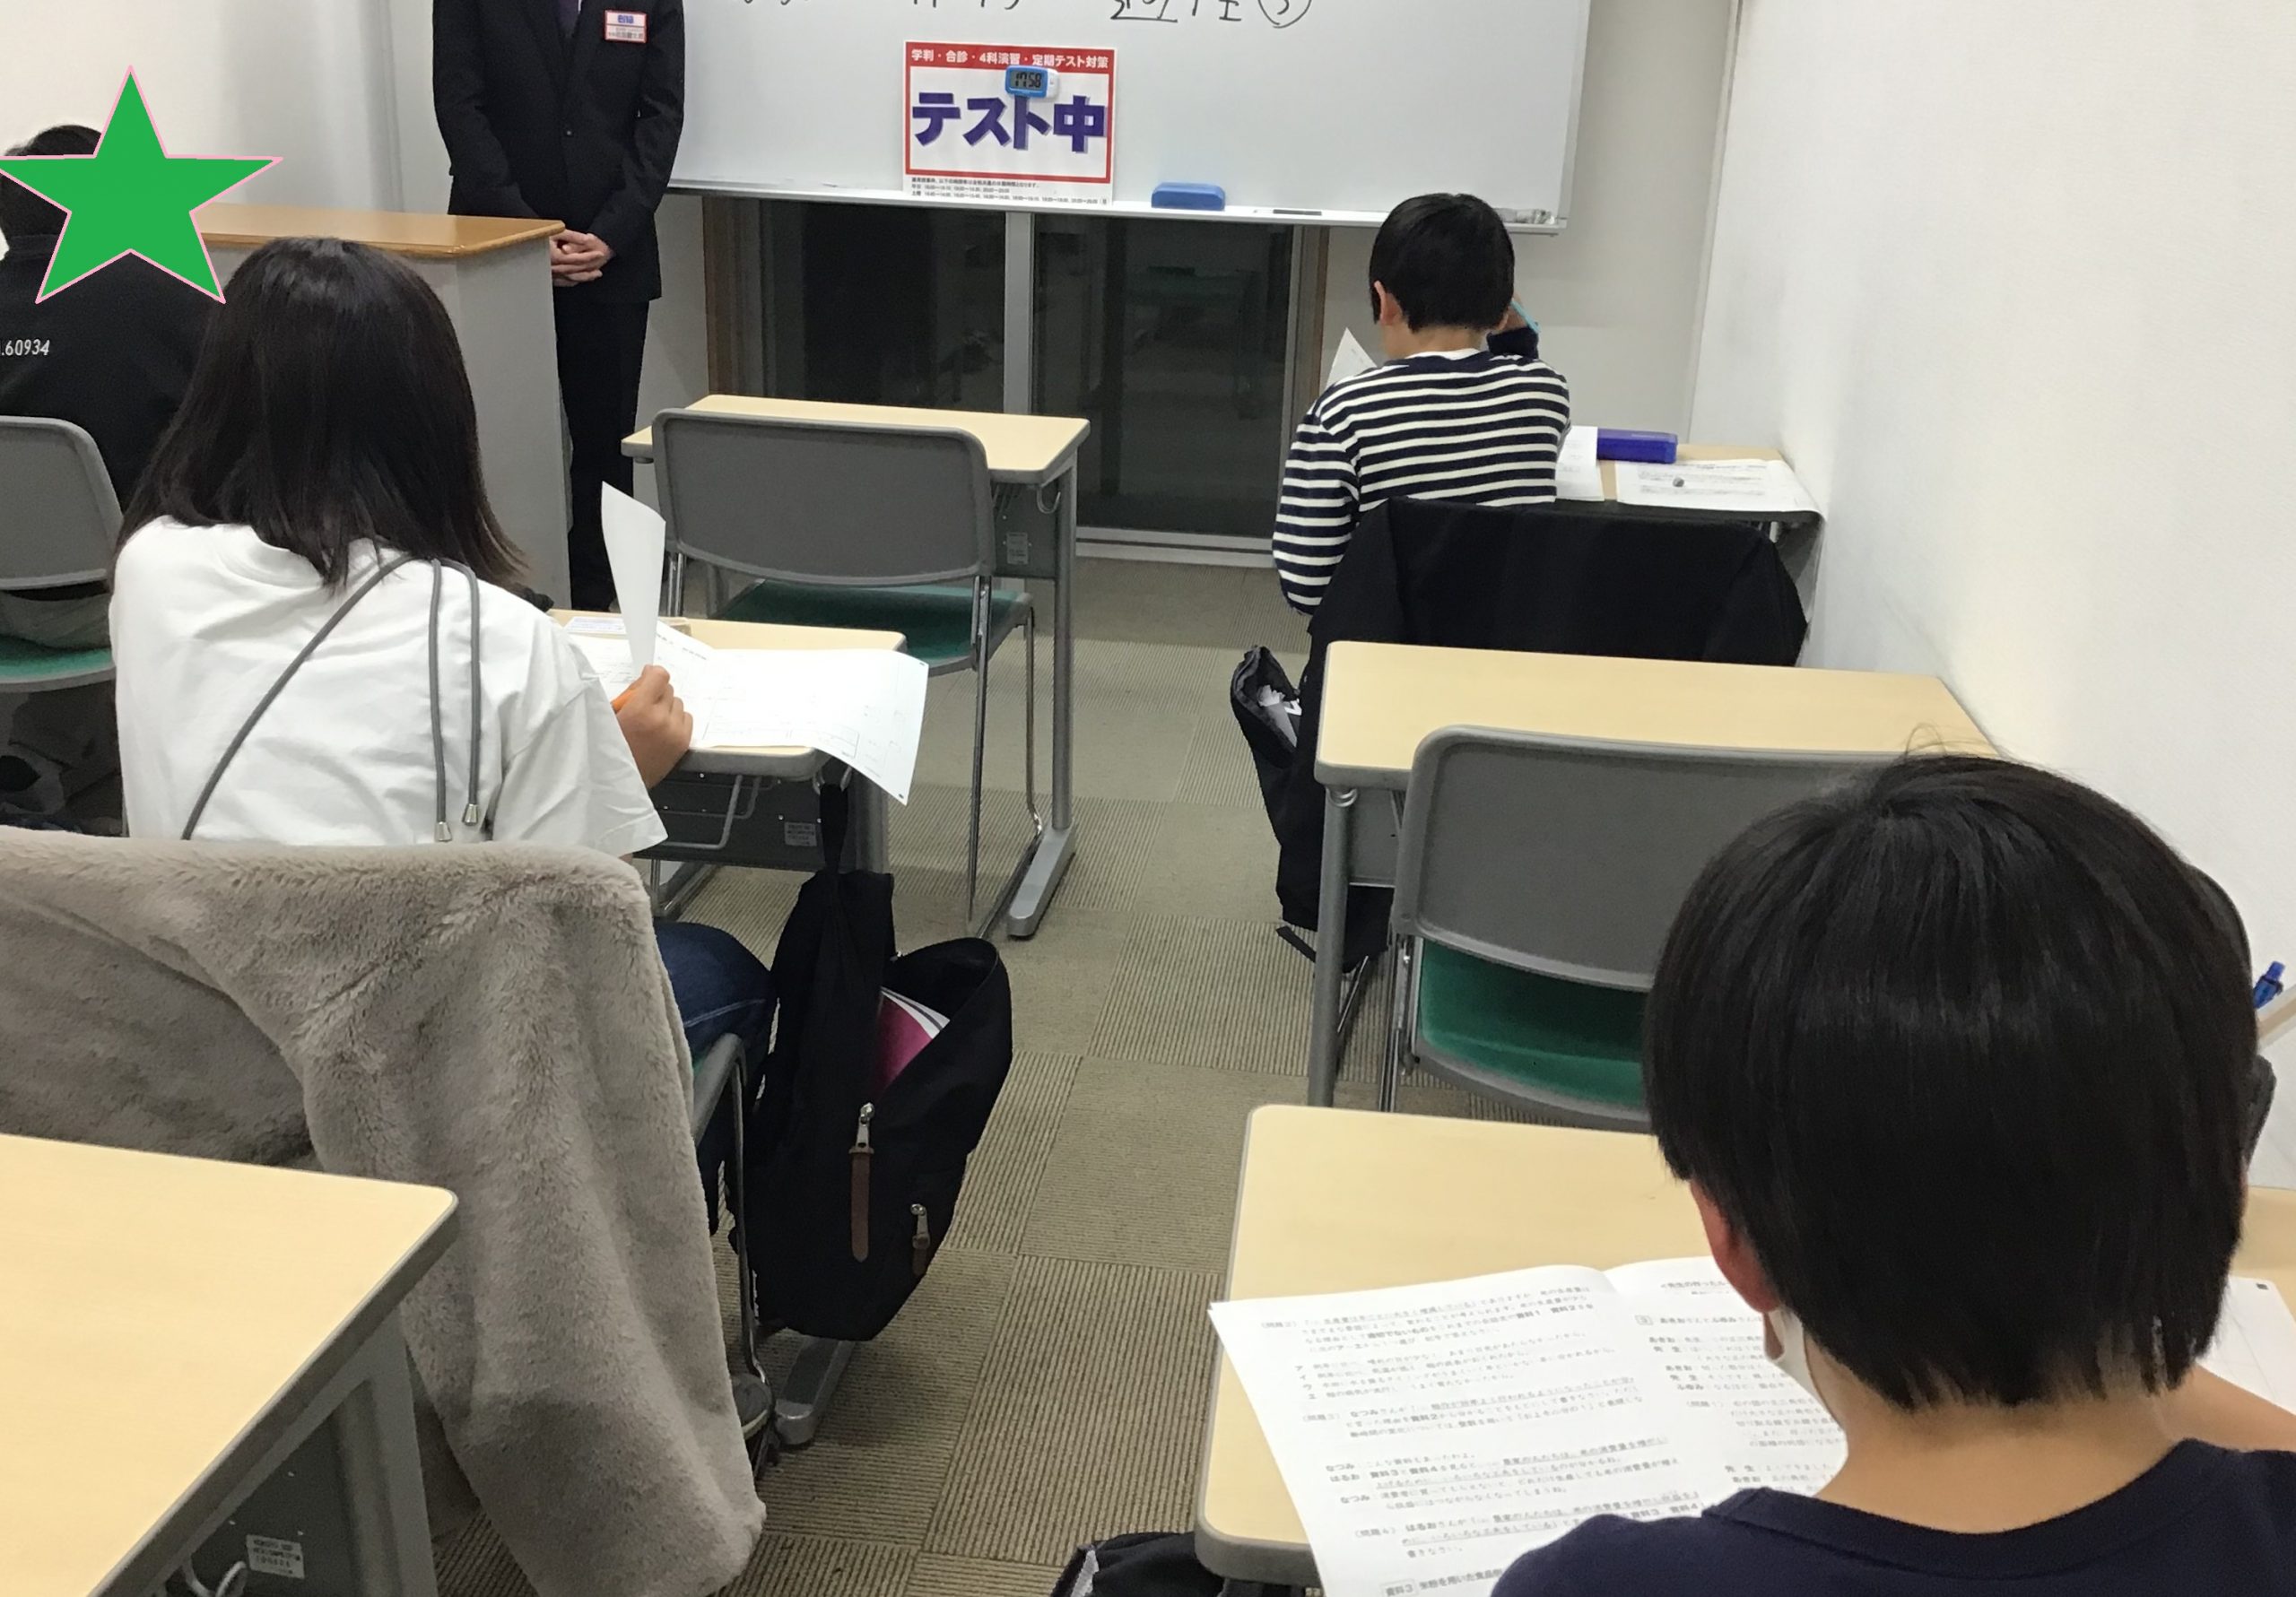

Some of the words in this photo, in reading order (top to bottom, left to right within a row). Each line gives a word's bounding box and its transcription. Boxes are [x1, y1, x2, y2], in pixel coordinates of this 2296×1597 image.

[912, 92, 1108, 153] テスト中
[0, 339, 50, 356] .60934
